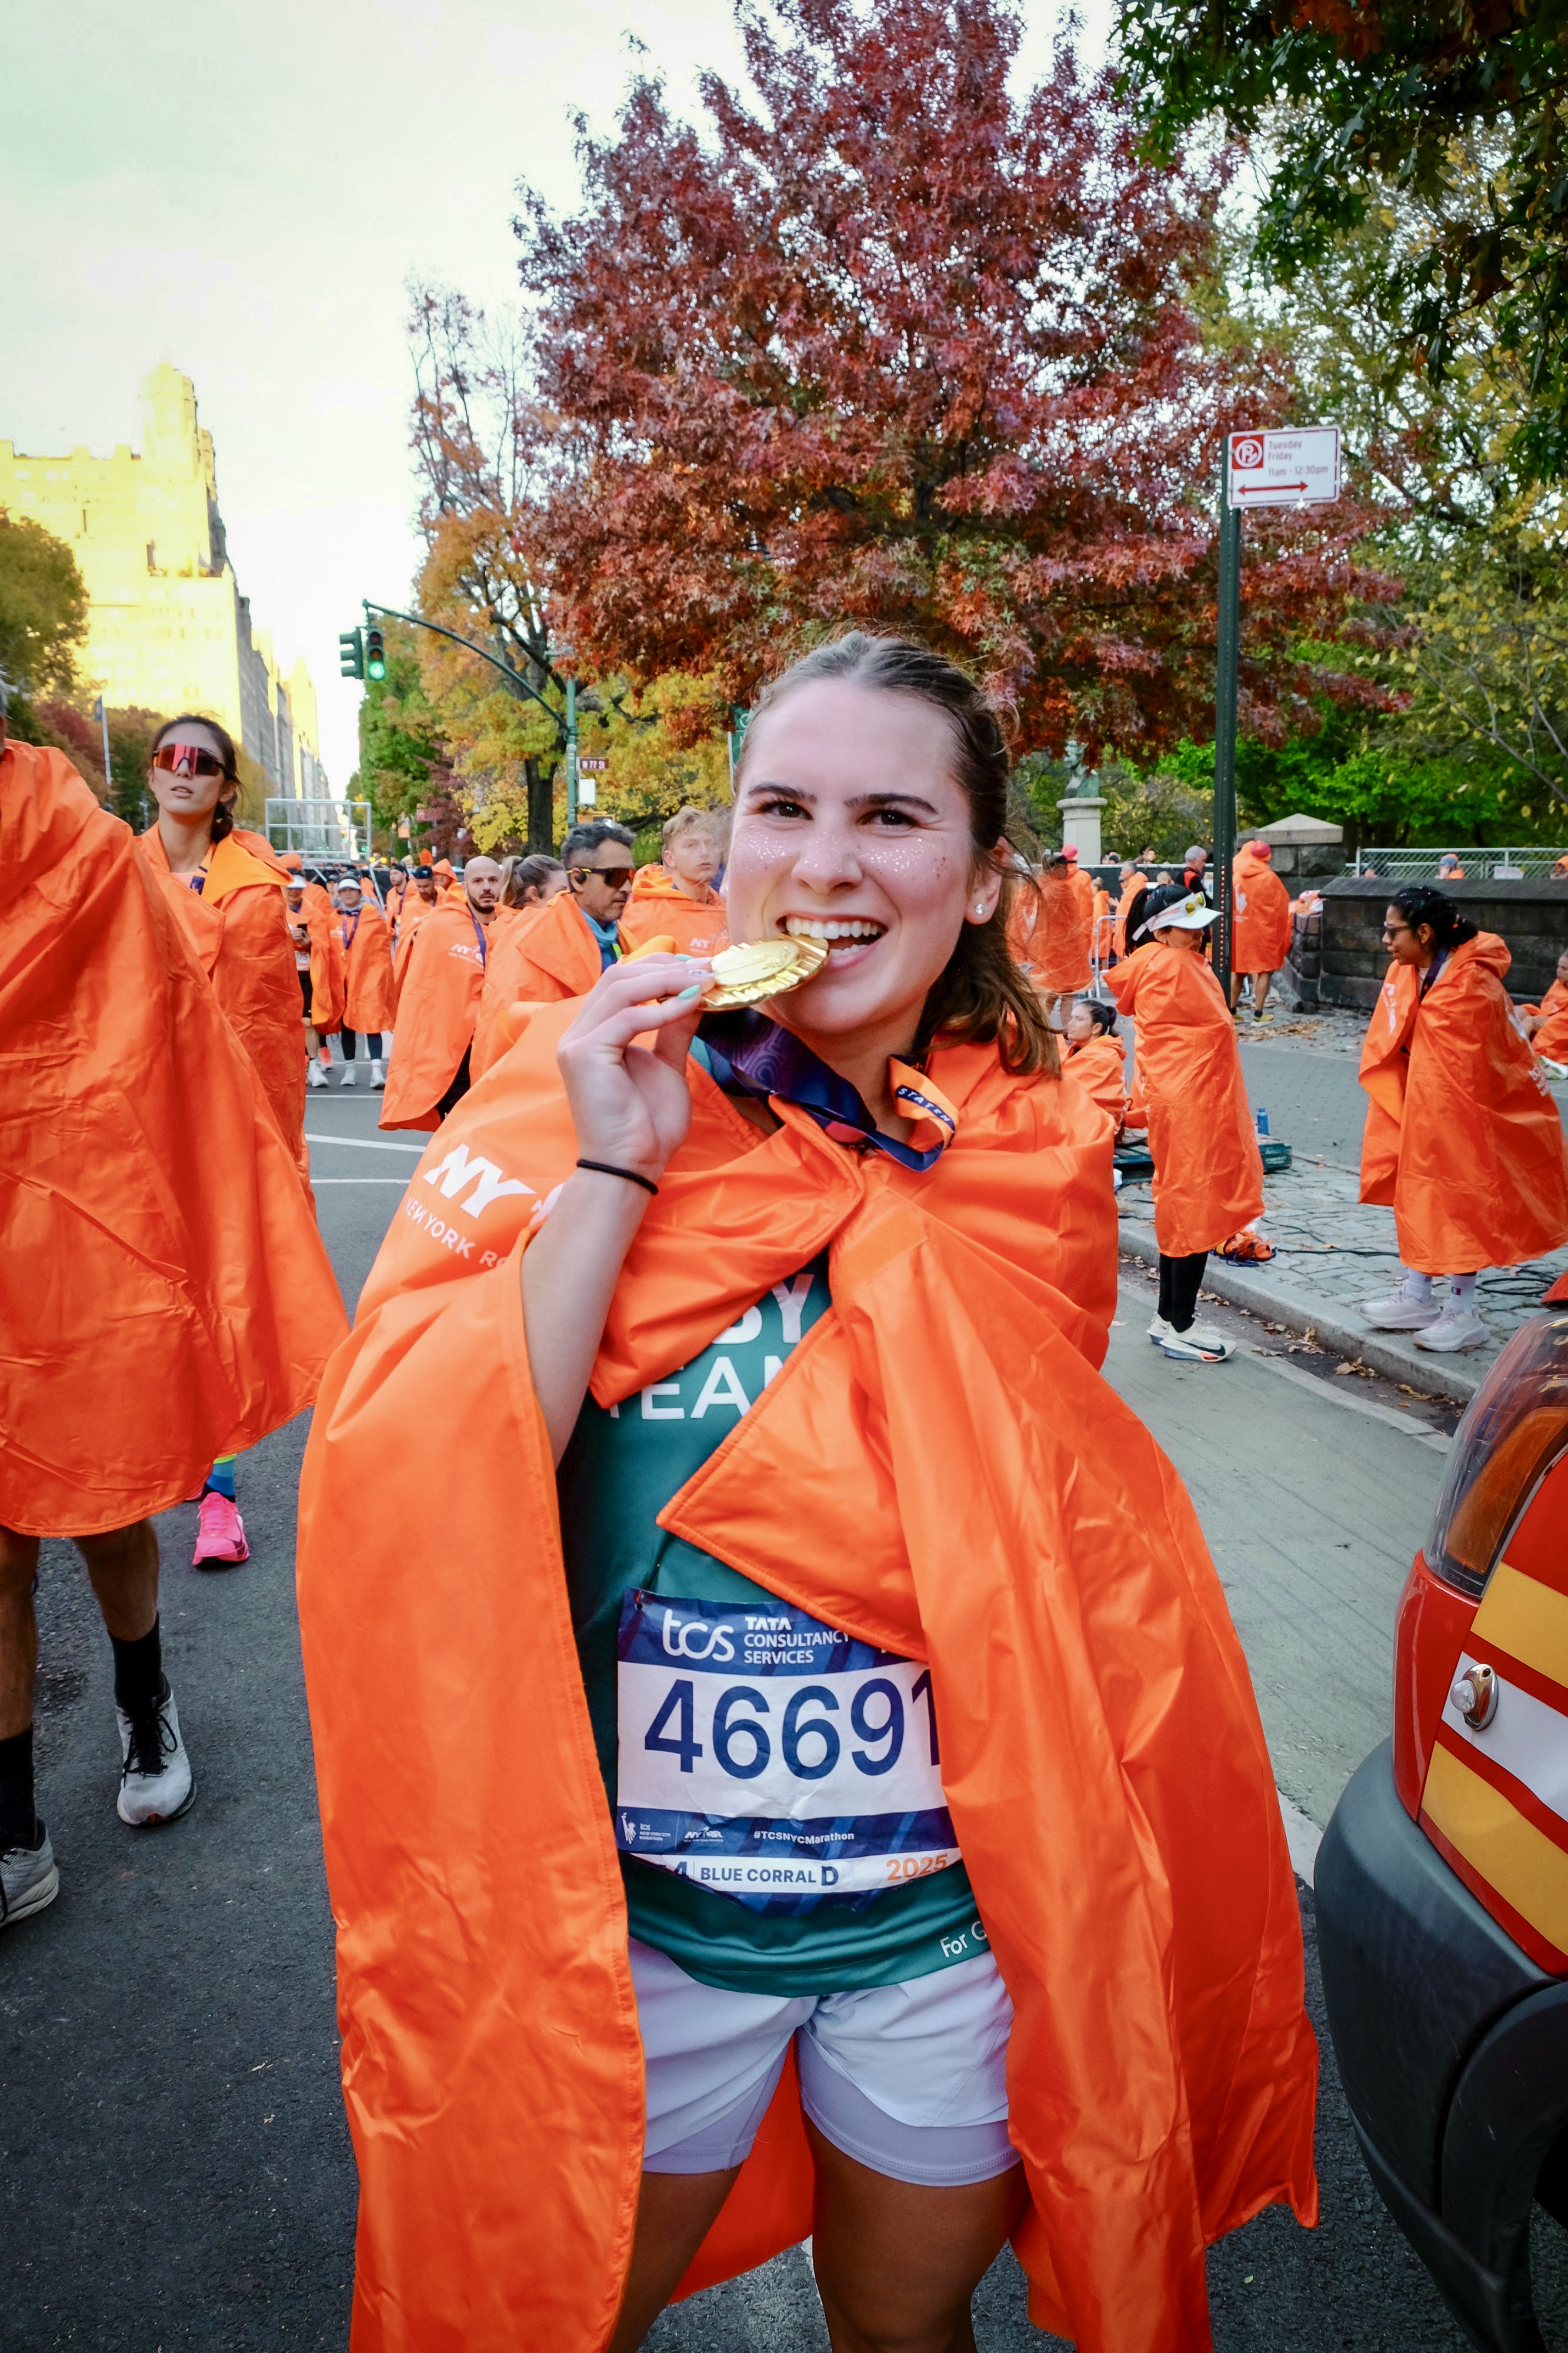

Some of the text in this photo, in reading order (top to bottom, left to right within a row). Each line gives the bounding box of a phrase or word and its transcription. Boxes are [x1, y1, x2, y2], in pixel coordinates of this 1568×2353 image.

[1268, 440, 1302, 449] Tuesday
[1268, 452, 1293, 461] Friday
[1268, 468, 1287, 476] 11am
[1295, 465, 1329, 476] 12:30pm
[898, 1088, 951, 1122] STATEN
[423, 1143, 537, 1219] NY
[405, 1196, 428, 1224] NEW
[423, 1213, 476, 1259] YORK
[609, 1355, 784, 1419] EA
[662, 1609, 735, 1662] tcs
[745, 1617, 792, 1631] TATA
[743, 1649, 814, 1665] SERVICES
[645, 1668, 941, 1780] 46691
[753, 1831, 855, 1845] #TCSNYCMarathon
[700, 1865, 839, 1886] BLUE CORRAL D
[886, 1854, 948, 1881] 2025
[940, 1934, 968, 1958] For
